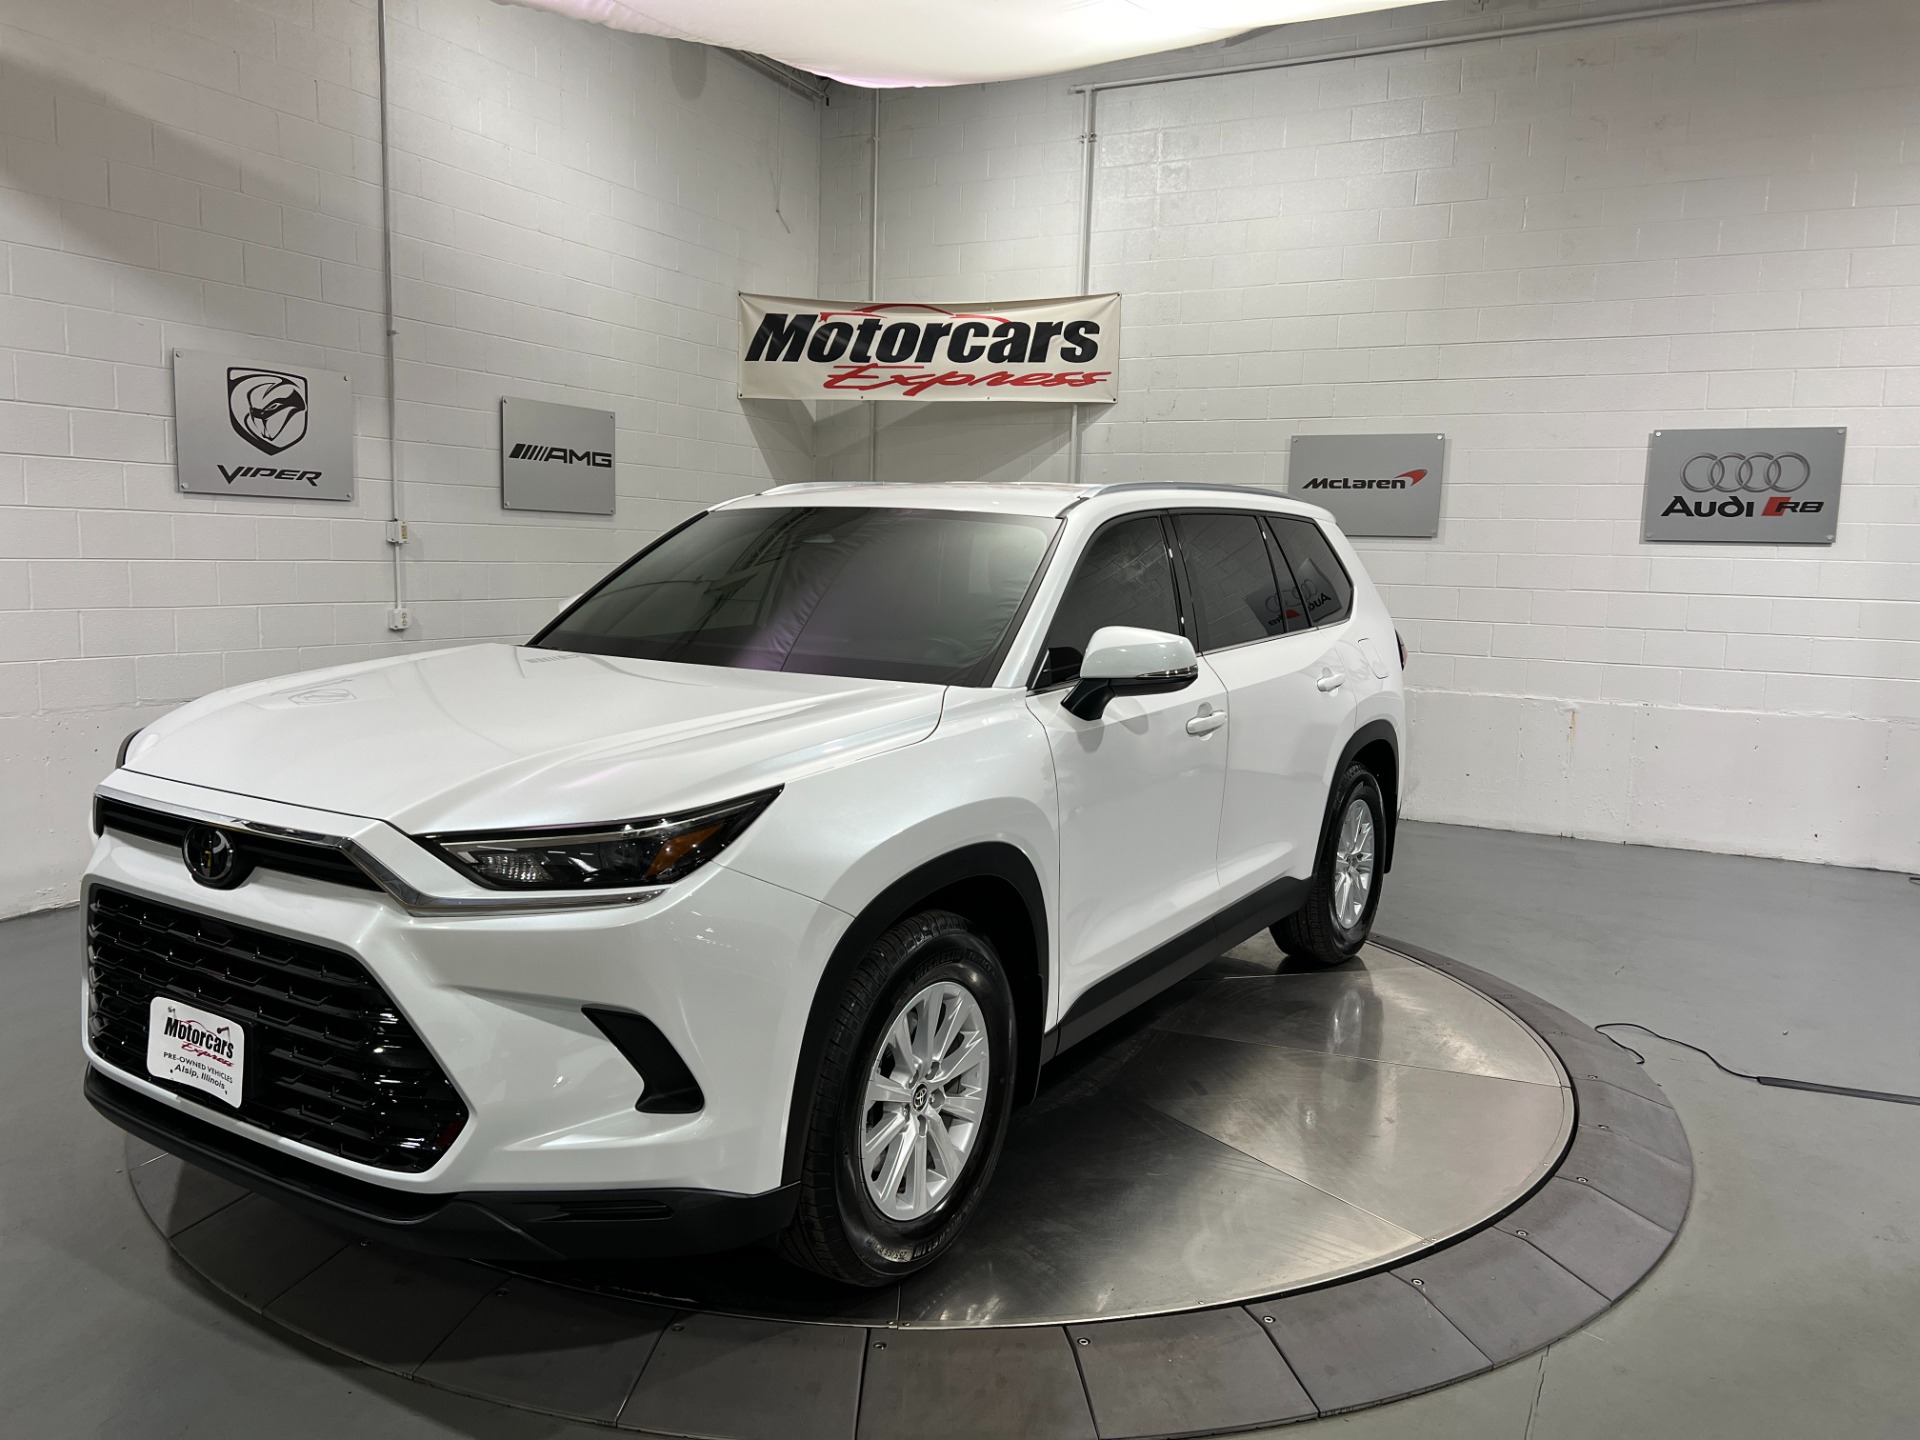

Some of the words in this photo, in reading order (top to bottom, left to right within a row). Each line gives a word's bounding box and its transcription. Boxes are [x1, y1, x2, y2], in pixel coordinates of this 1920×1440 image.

[744, 312, 1101, 363] Motorcars
[823, 362, 1112, 397] Express
[543, 447, 612, 468] AMG
[216, 464, 323, 487] VIPER
[1302, 477, 1406, 490] McLaren
[1660, 495, 1754, 518] Audi
[1775, 501, 1824, 513] R8
[164, 1016, 234, 1059] Motorcars
[163, 1051, 207, 1071] PRE-OWNED
[207, 1065, 233, 1084] VEHICLES
[181, 1040, 235, 1068] Express
[174, 1064, 199, 1079] Alsip,
[201, 1072, 226, 1090] Illinois
